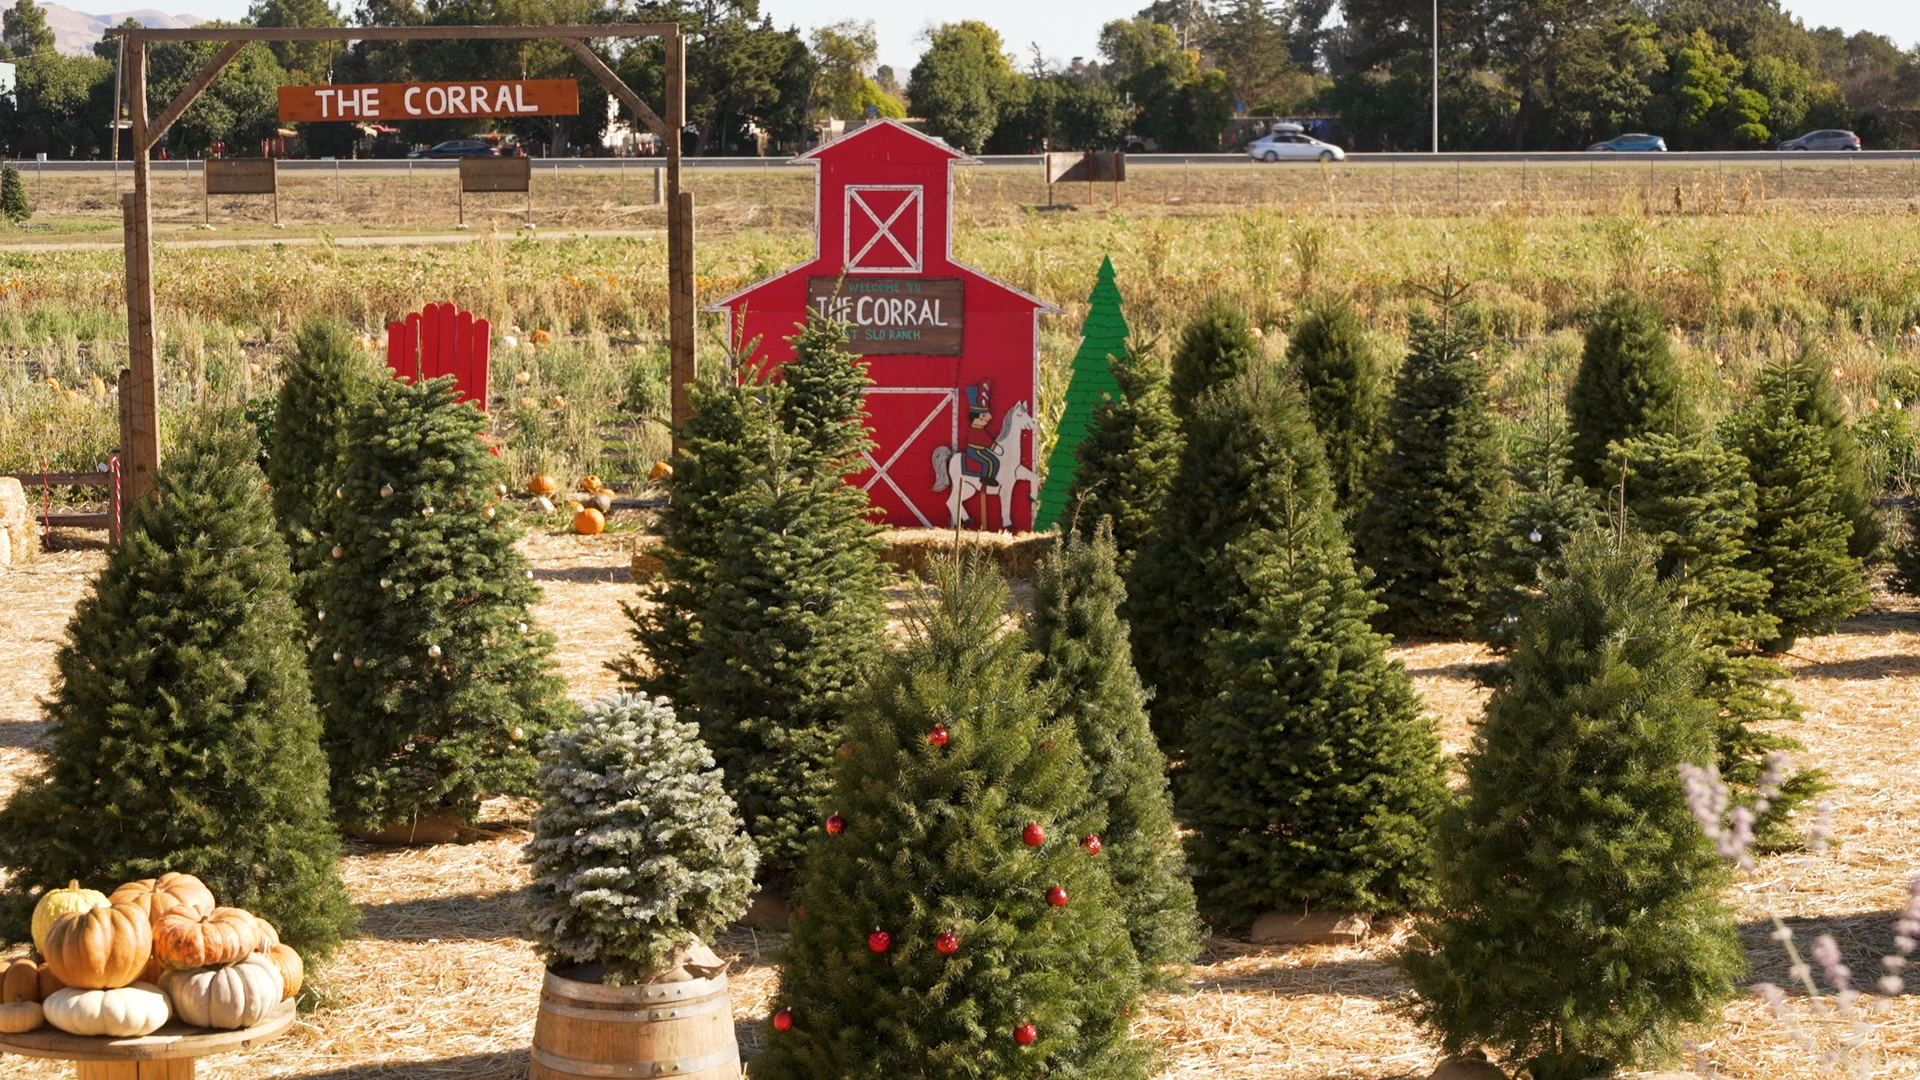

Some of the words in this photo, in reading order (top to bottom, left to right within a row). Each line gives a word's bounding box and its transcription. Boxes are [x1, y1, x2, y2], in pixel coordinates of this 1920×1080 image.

[315, 88, 380, 118] THE
[404, 84, 539, 115] CORRAL
[848, 283, 900, 293] WELCOME
[906, 283, 921, 293] TO
[856, 295, 949, 327] CORRAL
[865, 329, 886, 341] SLO
[889, 330, 921, 340] RANCH
